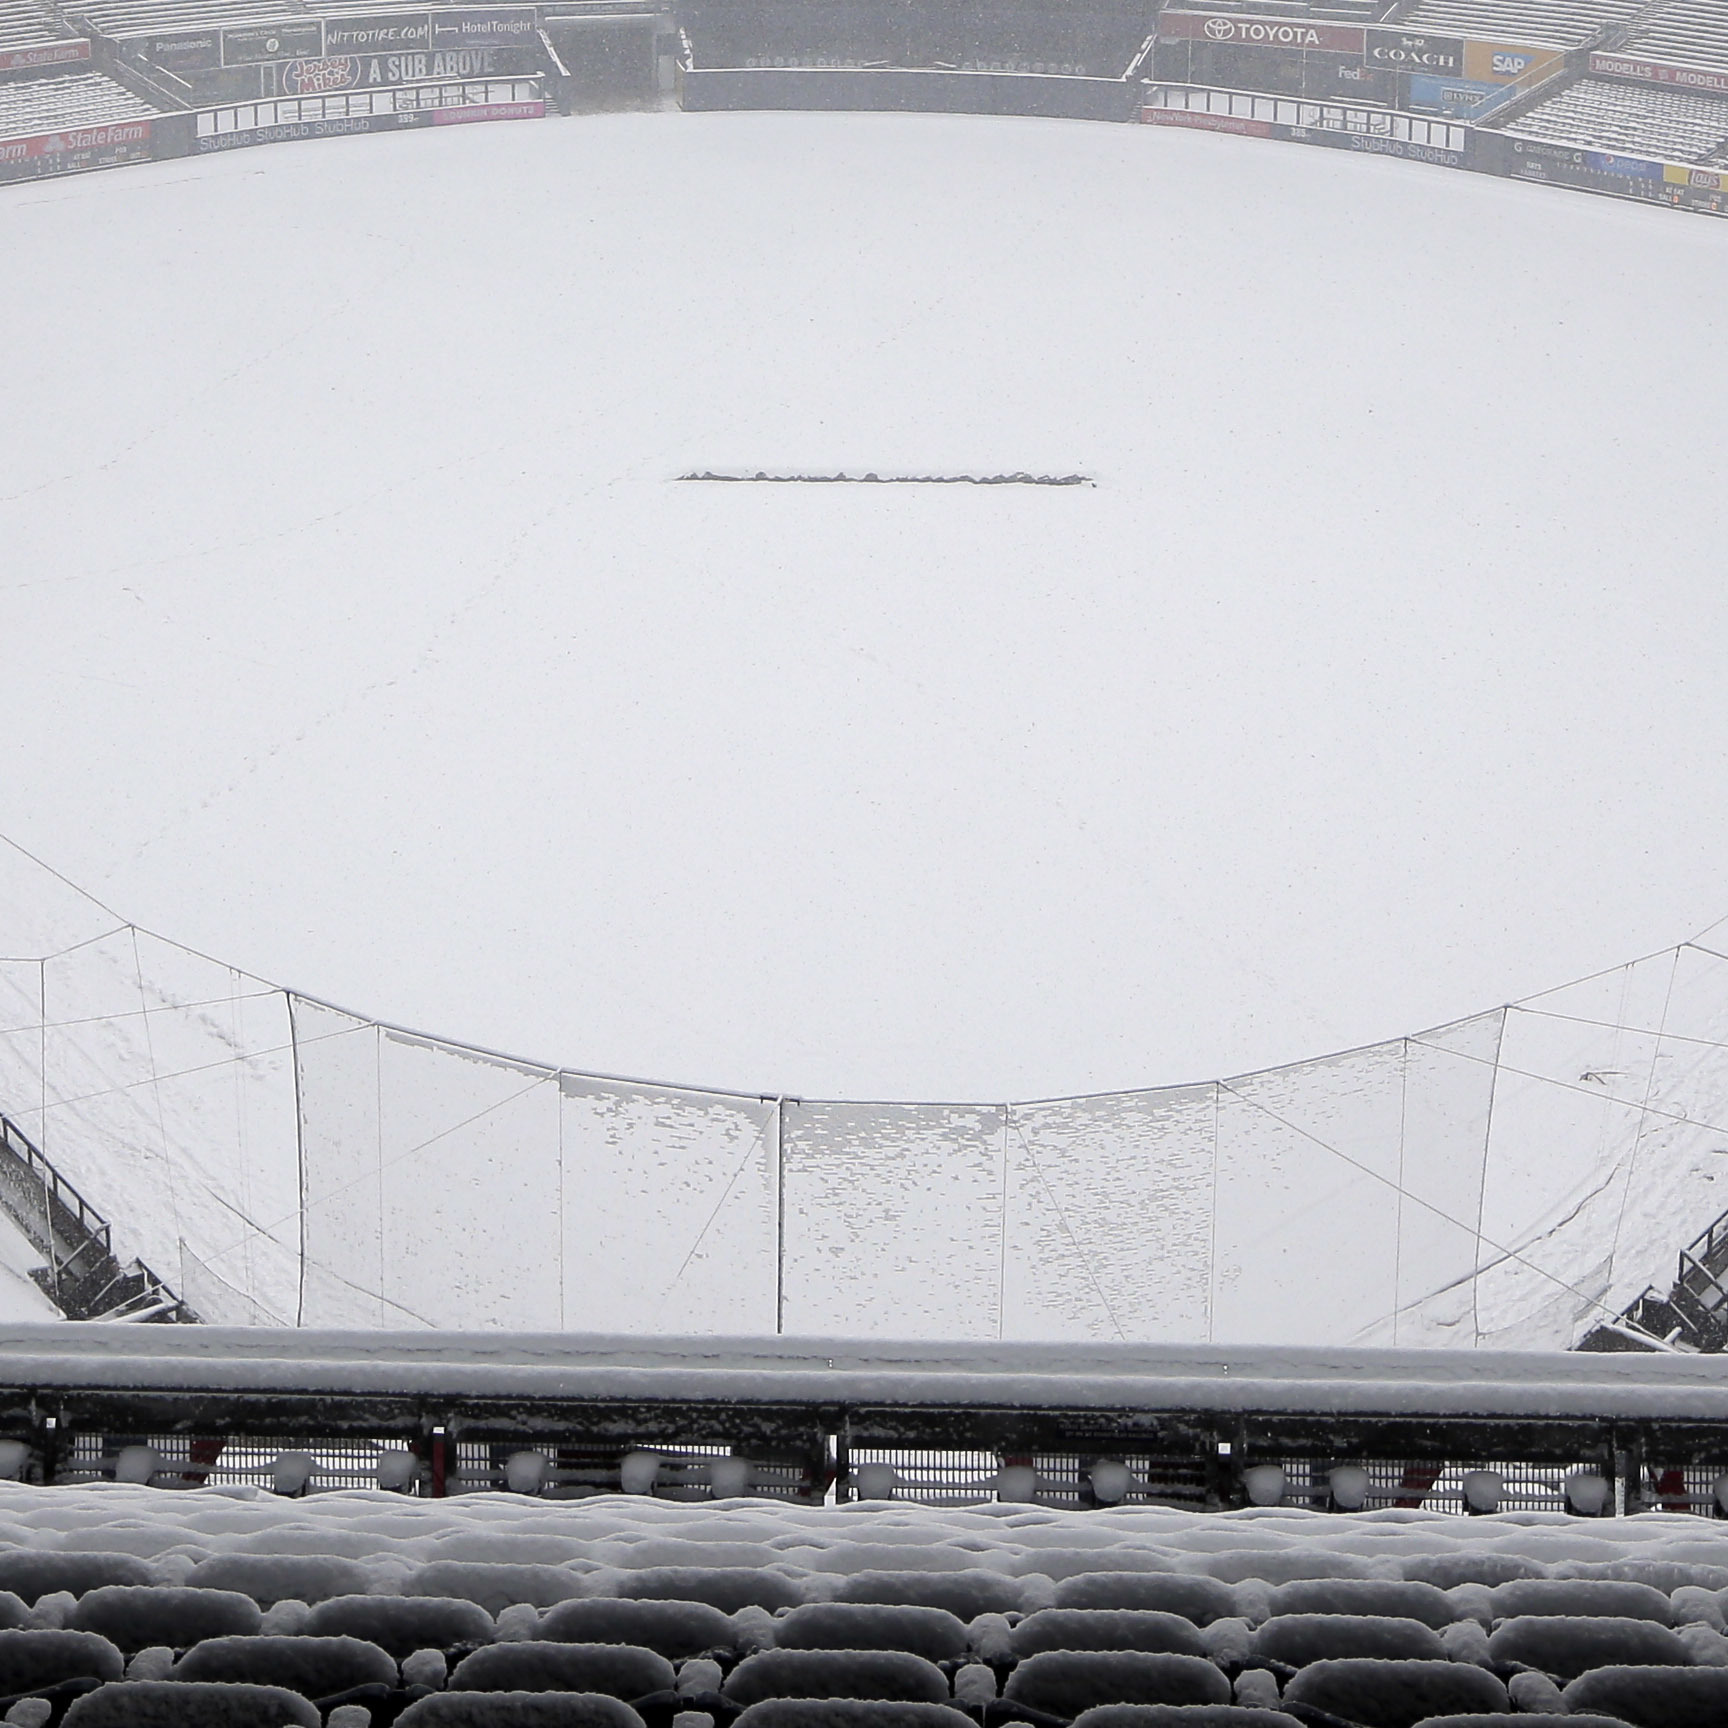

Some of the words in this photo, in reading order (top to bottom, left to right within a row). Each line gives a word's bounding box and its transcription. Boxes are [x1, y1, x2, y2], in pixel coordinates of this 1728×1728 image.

[326, 26, 429, 46] NITTOTIRE.COM
[1238, 23, 1320, 45] TOYOTA
[293, 56, 351, 80] Jersey
[368, 60, 382, 83] A
[388, 55, 425, 81] SUB
[433, 50, 494, 76] ABOVE
[1373, 47, 1454, 68] COACH
[1492, 55, 1525, 73] SAP
[1595, 59, 1651, 78] MODELL'S
[200, 132, 251, 151] StubHub
[256, 124, 308, 142] StubHub
[315, 118, 369, 136] StubHub
[1352, 136, 1403, 155] StubHub
[1408, 145, 1458, 165] StubHub
